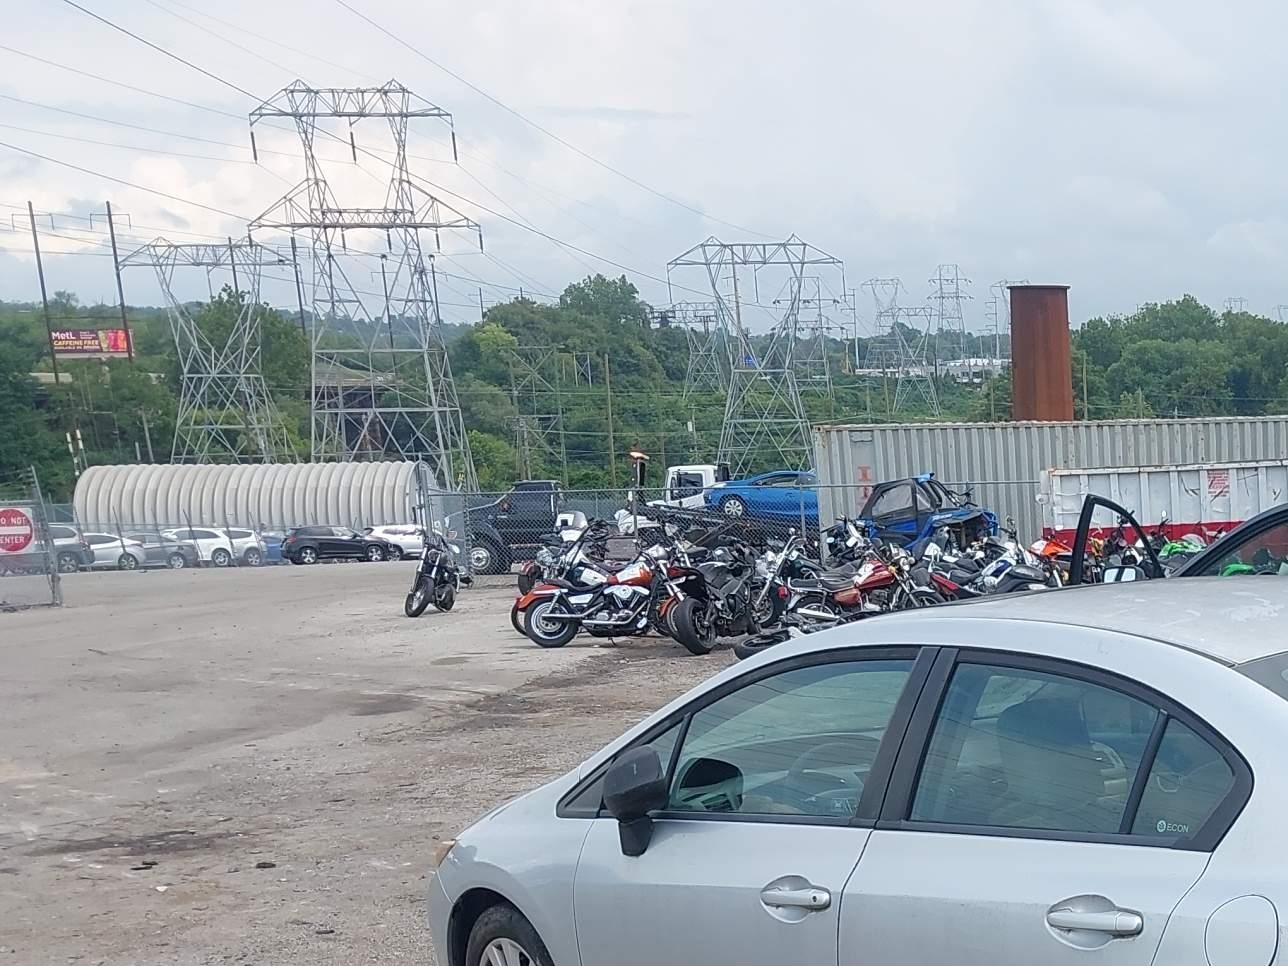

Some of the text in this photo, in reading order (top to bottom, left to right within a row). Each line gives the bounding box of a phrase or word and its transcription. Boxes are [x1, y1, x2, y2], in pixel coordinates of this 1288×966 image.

[0, 516, 26, 525] O NOT
[0, 535, 25, 544] ENTER
[1167, 823, 1189, 833] ECON
